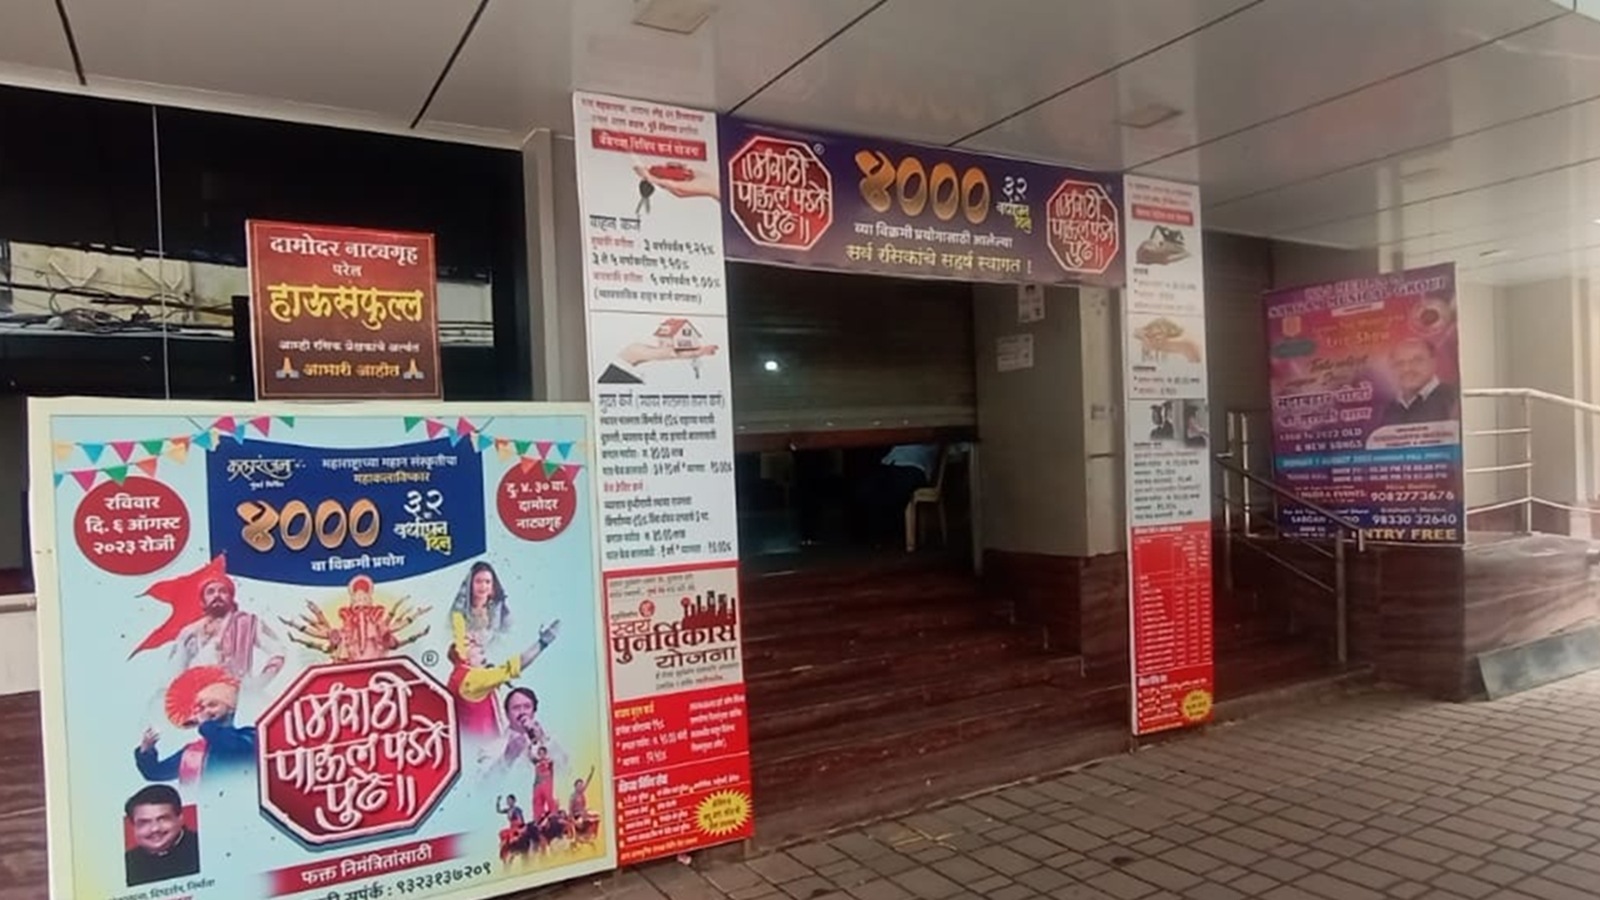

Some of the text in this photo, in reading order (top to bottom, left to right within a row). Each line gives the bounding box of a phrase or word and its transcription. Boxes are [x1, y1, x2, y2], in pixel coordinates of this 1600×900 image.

[269, 233, 341, 257] दामोदर
[846, 242, 874, 261] सर्व
[332, 260, 363, 277] परेल
[267, 283, 424, 330] हाऊसफुल्ल
[303, 360, 401, 378] आभारी आहोत
[382, 457, 407, 467] महान
[104, 493, 161, 511] रविवार
[518, 497, 559, 512] दामोदर
[85, 514, 182, 534] दि. ६ ऑगस्ट
[1411, 527, 1457, 540] FREE
[94, 536, 176, 557] २०२३ रोजी
[311, 552, 405, 572] वा विक्रमी प्रयोग
[611, 621, 737, 664] पुनर्विकास
[653, 645, 738, 668] योजना
[301, 843, 434, 885] फक्त निमंत्रितांसाठी
